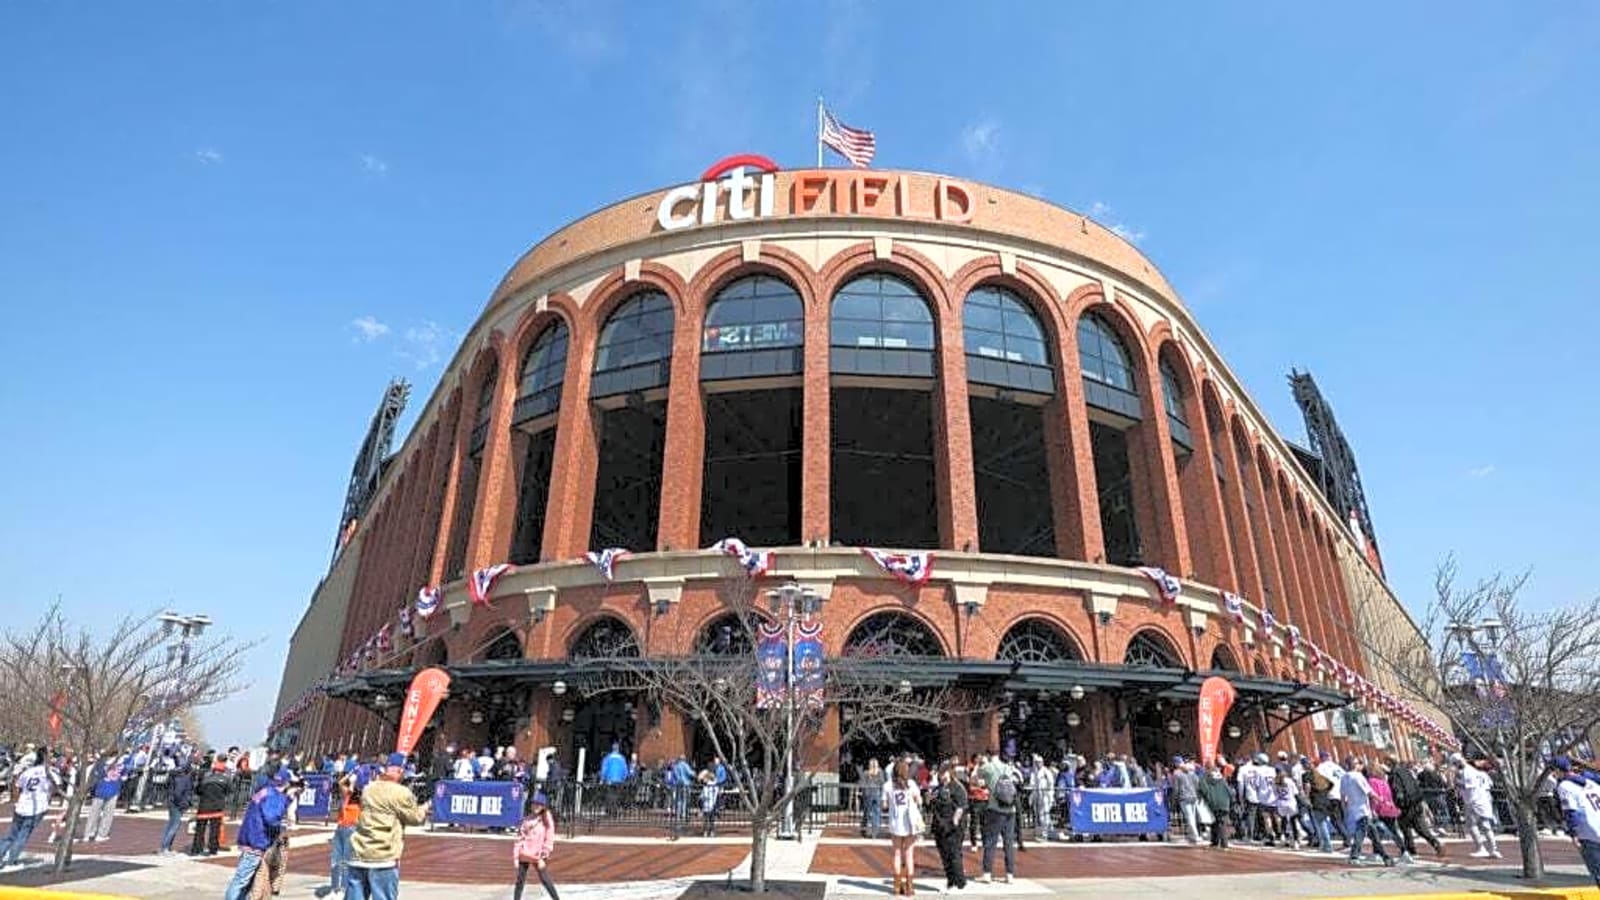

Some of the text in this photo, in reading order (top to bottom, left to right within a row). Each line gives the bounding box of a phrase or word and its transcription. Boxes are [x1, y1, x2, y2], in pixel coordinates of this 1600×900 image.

[657, 166, 976, 230] citi FIELD
[402, 689, 423, 761] ENTE
[1200, 697, 1214, 760] ENTE
[451, 794, 503, 816] ENTER HERE
[894, 791, 907, 806] 12
[1091, 802, 1149, 823] ENTER HERE
